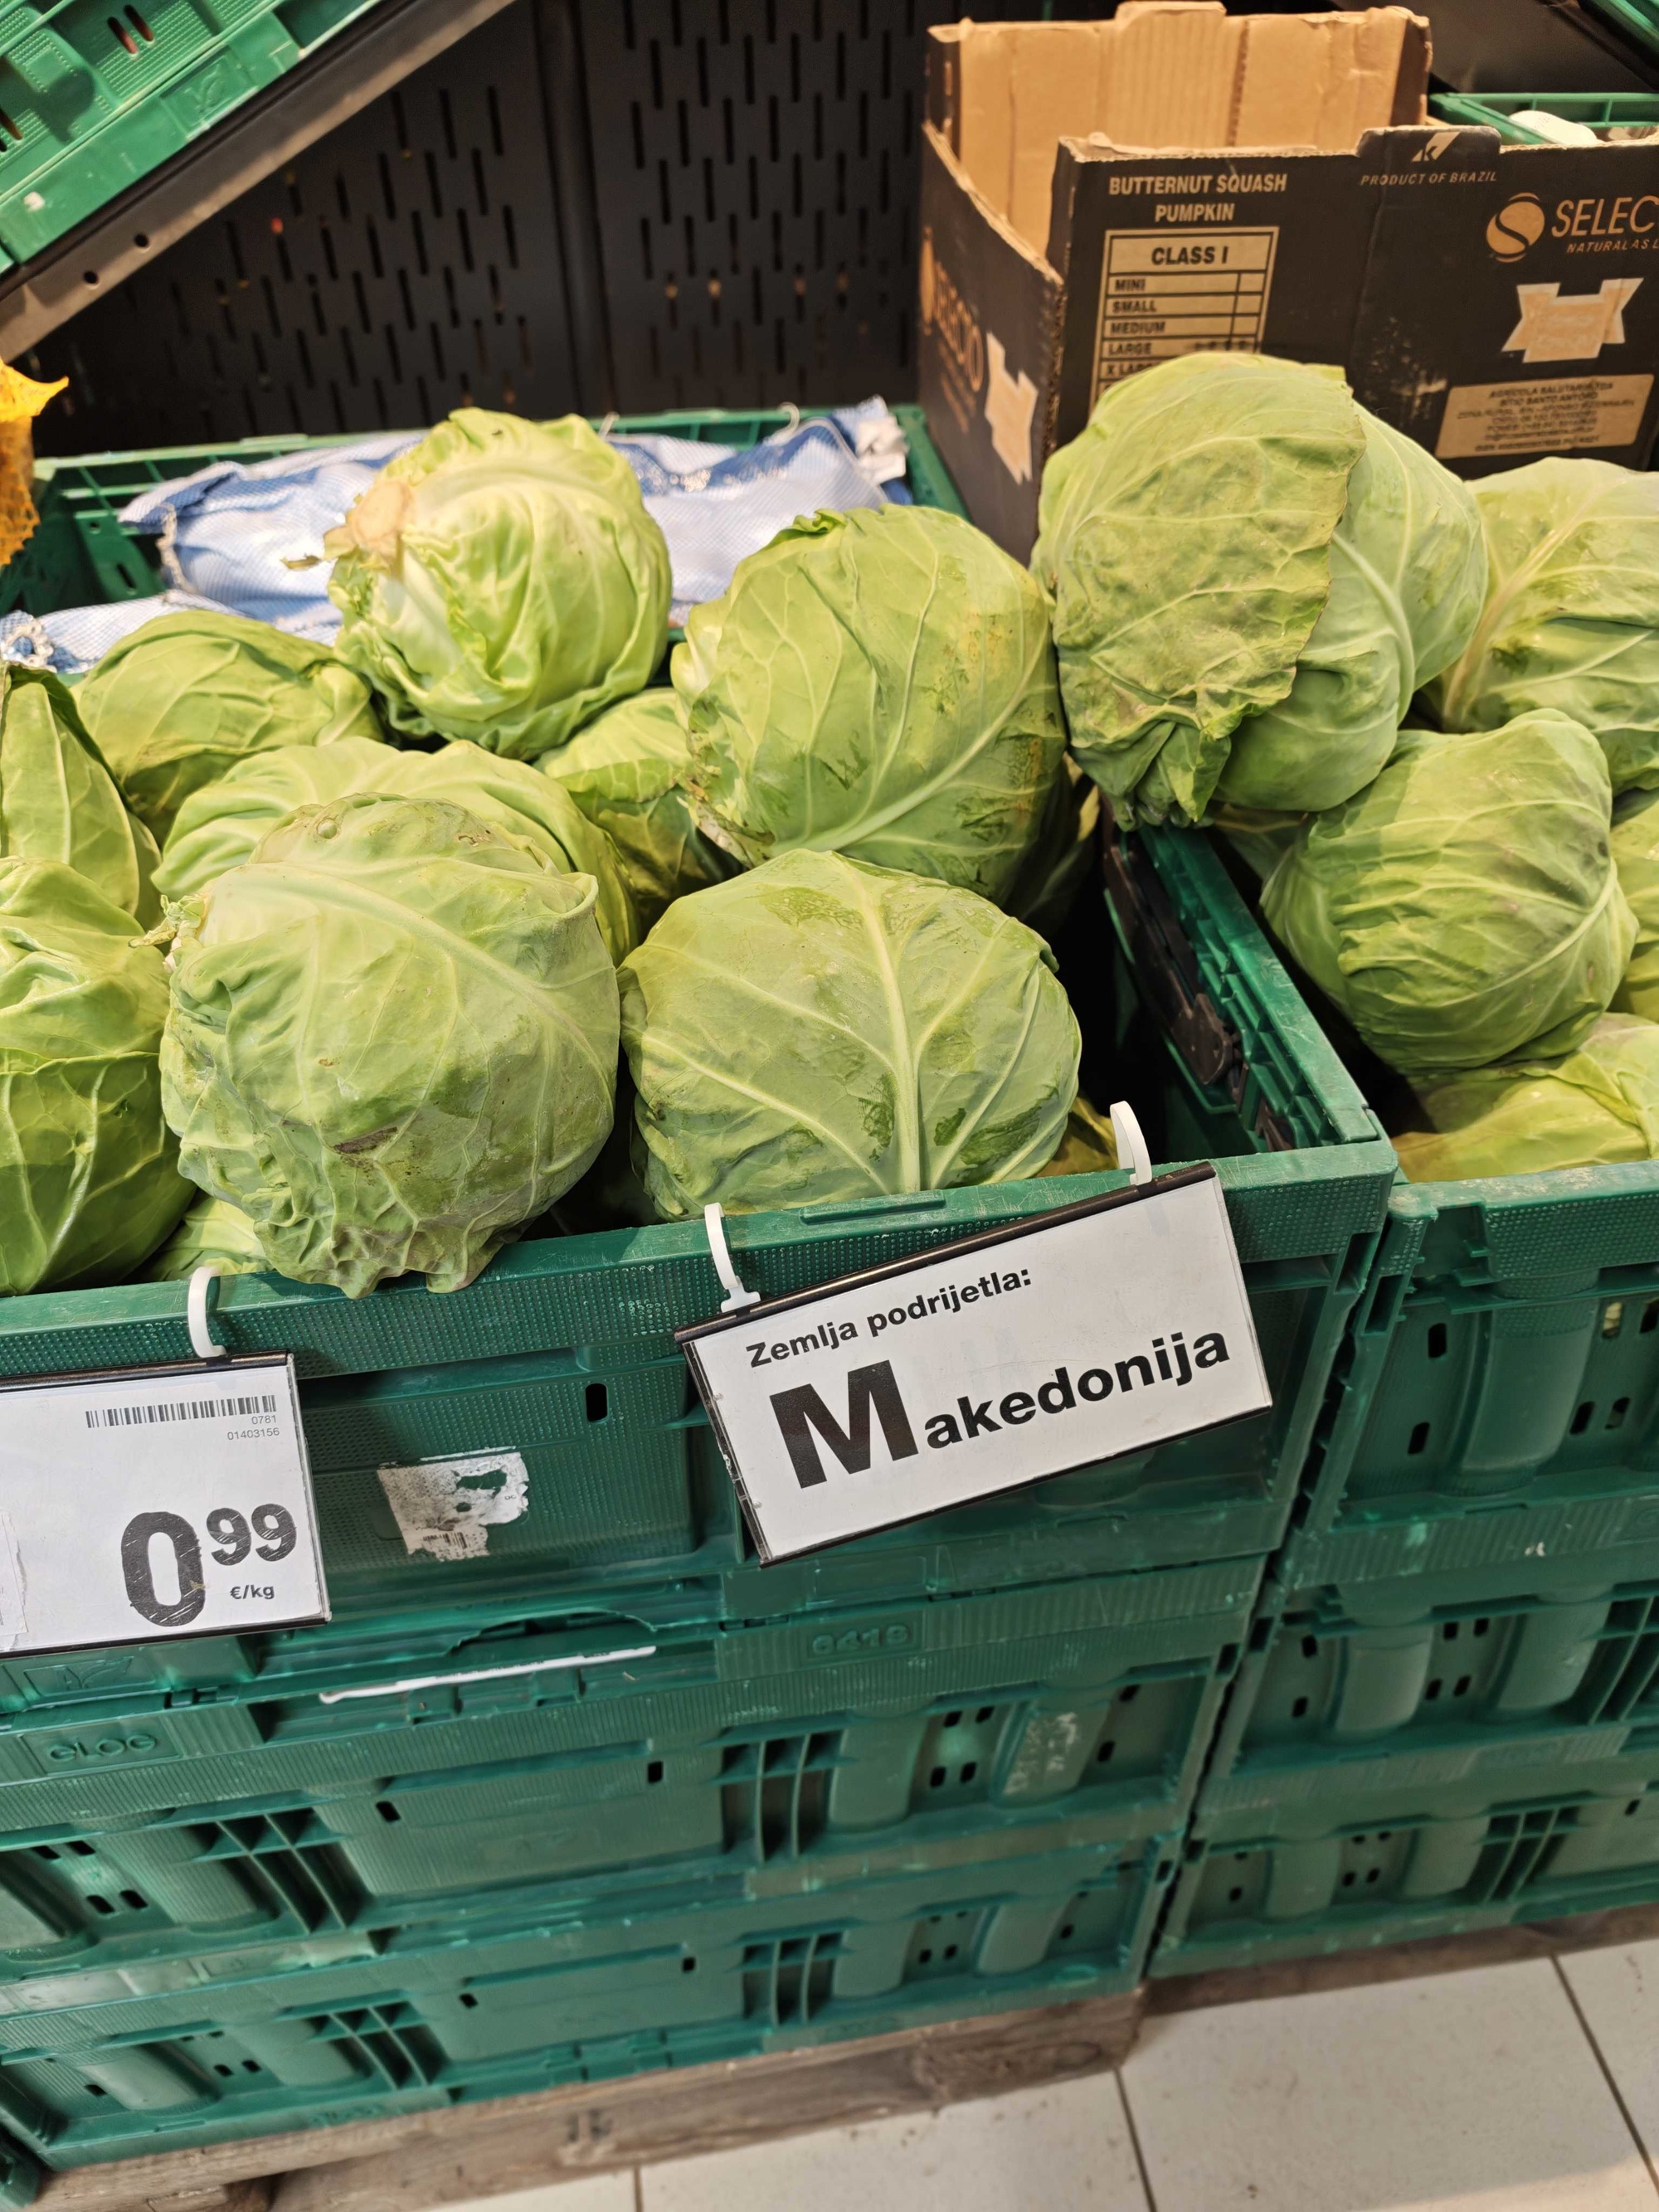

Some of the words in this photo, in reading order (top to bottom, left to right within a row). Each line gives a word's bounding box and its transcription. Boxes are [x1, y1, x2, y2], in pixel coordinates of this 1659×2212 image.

[1108, 175, 1214, 196] BUTTERNUT
[1216, 173, 1288, 193] SQUASH
[1360, 173, 1427, 186] PRODUCT
[1428, 173, 1447, 184] OF
[1449, 171, 1497, 183] BRAZIL
[1155, 203, 1236, 222] PUMPKIN
[1551, 195, 1659, 238] SELEC
[1566, 240, 1628, 253] NATURAL
[1632, 238, 1650, 250] AS
[1151, 246, 1216, 265] CLASS
[1221, 246, 1229, 265] I
[1114, 279, 1146, 292] MINI
[1112, 299, 1157, 314] SMALL
[1110, 320, 1166, 333] MEDIUM
[1108, 343, 1152, 356] LARGE
[746, 1321, 859, 1369] Zemlja
[866, 1268, 1033, 1338] podrijetla:
[770, 1330, 1231, 1490] Makedonija
[251, 1415, 276, 1425] 0781
[226, 1427, 280, 1441] 01403156
[230, 1584, 275, 1601] €/kg
